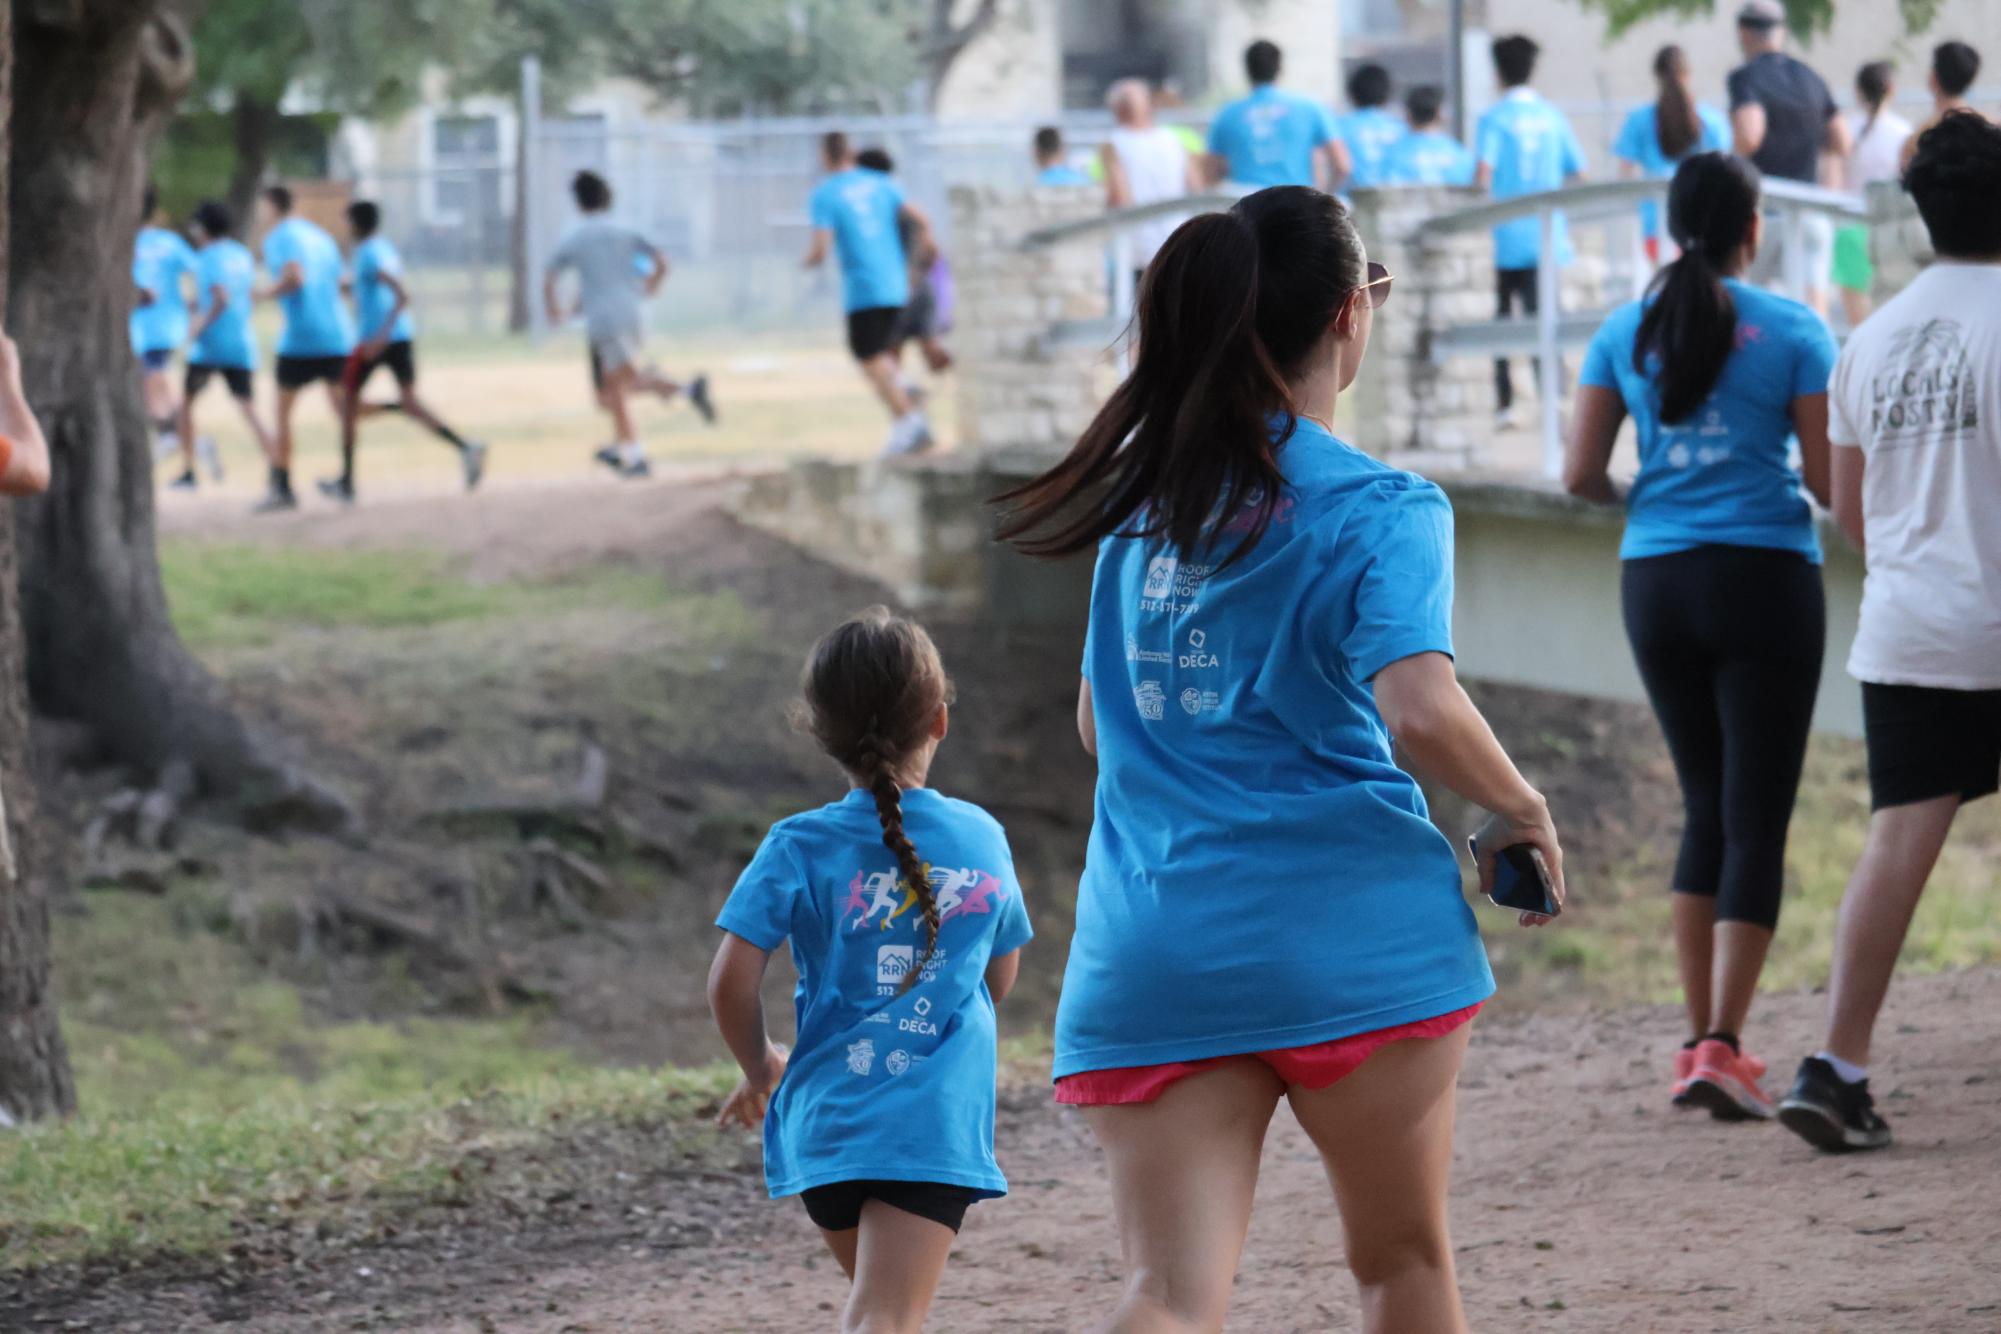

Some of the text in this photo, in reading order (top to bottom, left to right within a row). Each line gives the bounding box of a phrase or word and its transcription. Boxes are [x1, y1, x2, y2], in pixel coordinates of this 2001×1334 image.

[1175, 574, 1203, 586] RIG
[1179, 654, 1219, 669] DECA
[916, 949, 946, 960] ROF
[898, 1018, 937, 1036] DECA
